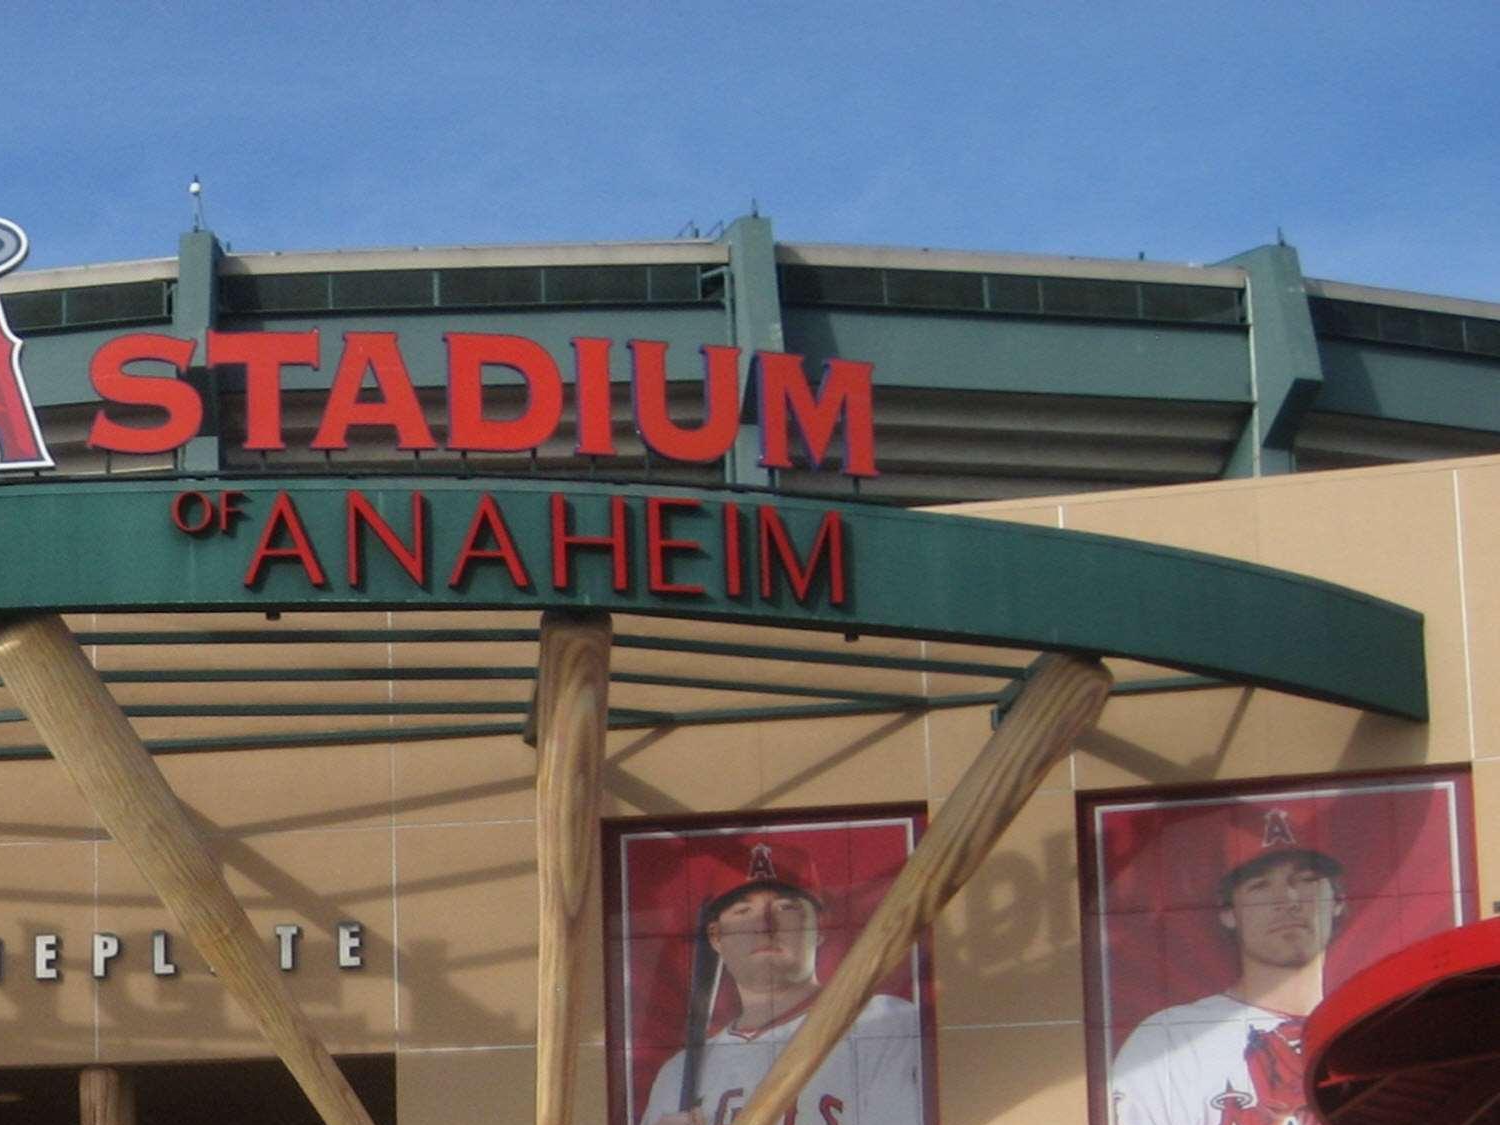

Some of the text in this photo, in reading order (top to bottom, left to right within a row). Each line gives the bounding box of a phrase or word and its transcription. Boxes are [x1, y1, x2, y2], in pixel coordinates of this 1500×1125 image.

[86, 328, 879, 477] STADIUM
[170, 489, 846, 605] OF ANAHEIM
